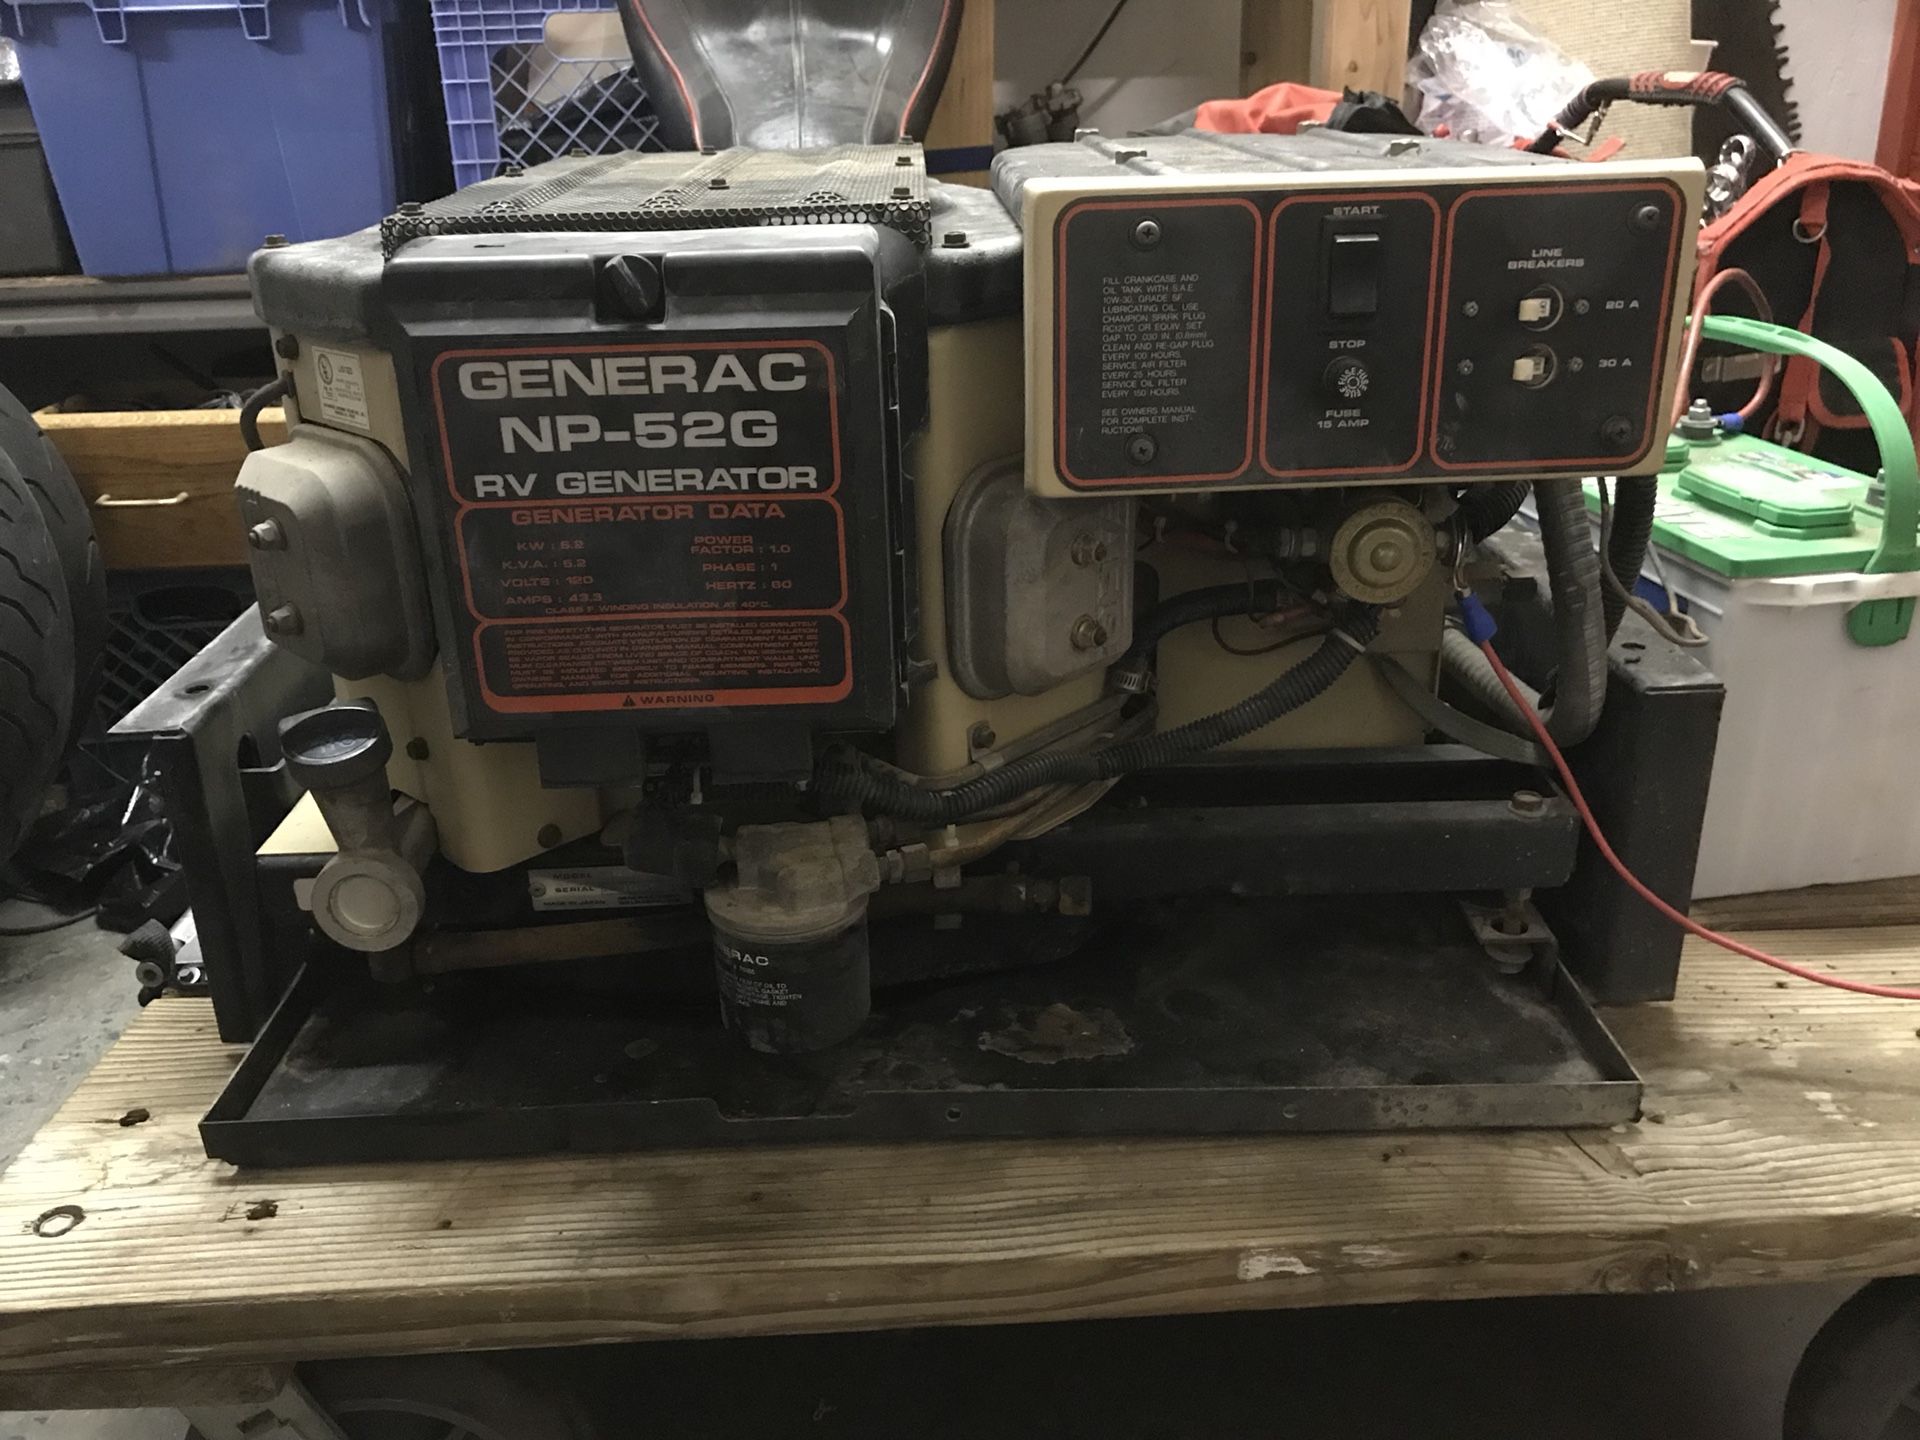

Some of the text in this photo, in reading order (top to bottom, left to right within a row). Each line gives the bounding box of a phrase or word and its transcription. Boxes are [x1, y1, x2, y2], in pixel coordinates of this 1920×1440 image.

[1332, 206, 1380, 216] START
[1532, 248, 1563, 258] LINE
[1507, 258, 1585, 270] BREAKERS
[1124, 274, 1176, 284] CRANKCASE
[1181, 274, 1198, 282] AND
[1103, 305, 1157, 313] LUBRICATING
[1605, 300, 1639, 310] 20 A
[1103, 315, 1148, 323] CHAMPION
[1183, 312, 1205, 320] PLUG
[1103, 334, 1120, 342] GAP
[1103, 344, 1130, 352] CLEAN
[1192, 340, 1214, 348] PLUG
[1329, 340, 1366, 349] STOP
[1102, 362, 1137, 370] SERVICE
[1159, 360, 1187, 368] FILTER
[1598, 358, 1632, 368] 30 A
[458, 353, 807, 400] GENERAC
[1102, 381, 1137, 389] SERVICE
[1102, 390, 1129, 398] EVERY
[1121, 407, 1158, 415] OWNERS
[1162, 406, 1196, 414] MANUAL
[1326, 409, 1361, 418] FUSE
[1123, 415, 1167, 424] COMPLETE
[1317, 418, 1369, 429] 15 AMP
[500, 411, 778, 454] NP-52G
[473, 466, 818, 498] RV GENERATOR
[511, 503, 785, 526] GENERATOR DATA
[694, 535, 753, 544] POWER
[517, 542, 544, 551] KW
[690, 545, 791, 554] FACTOR 1.0
[703, 562, 777, 572] PHASE 1
[500, 576, 594, 587] VOLTS 120
[706, 580, 792, 590] HERTZ 60
[505, 595, 552, 605] AMPS
[640, 694, 714, 704] WARNING
